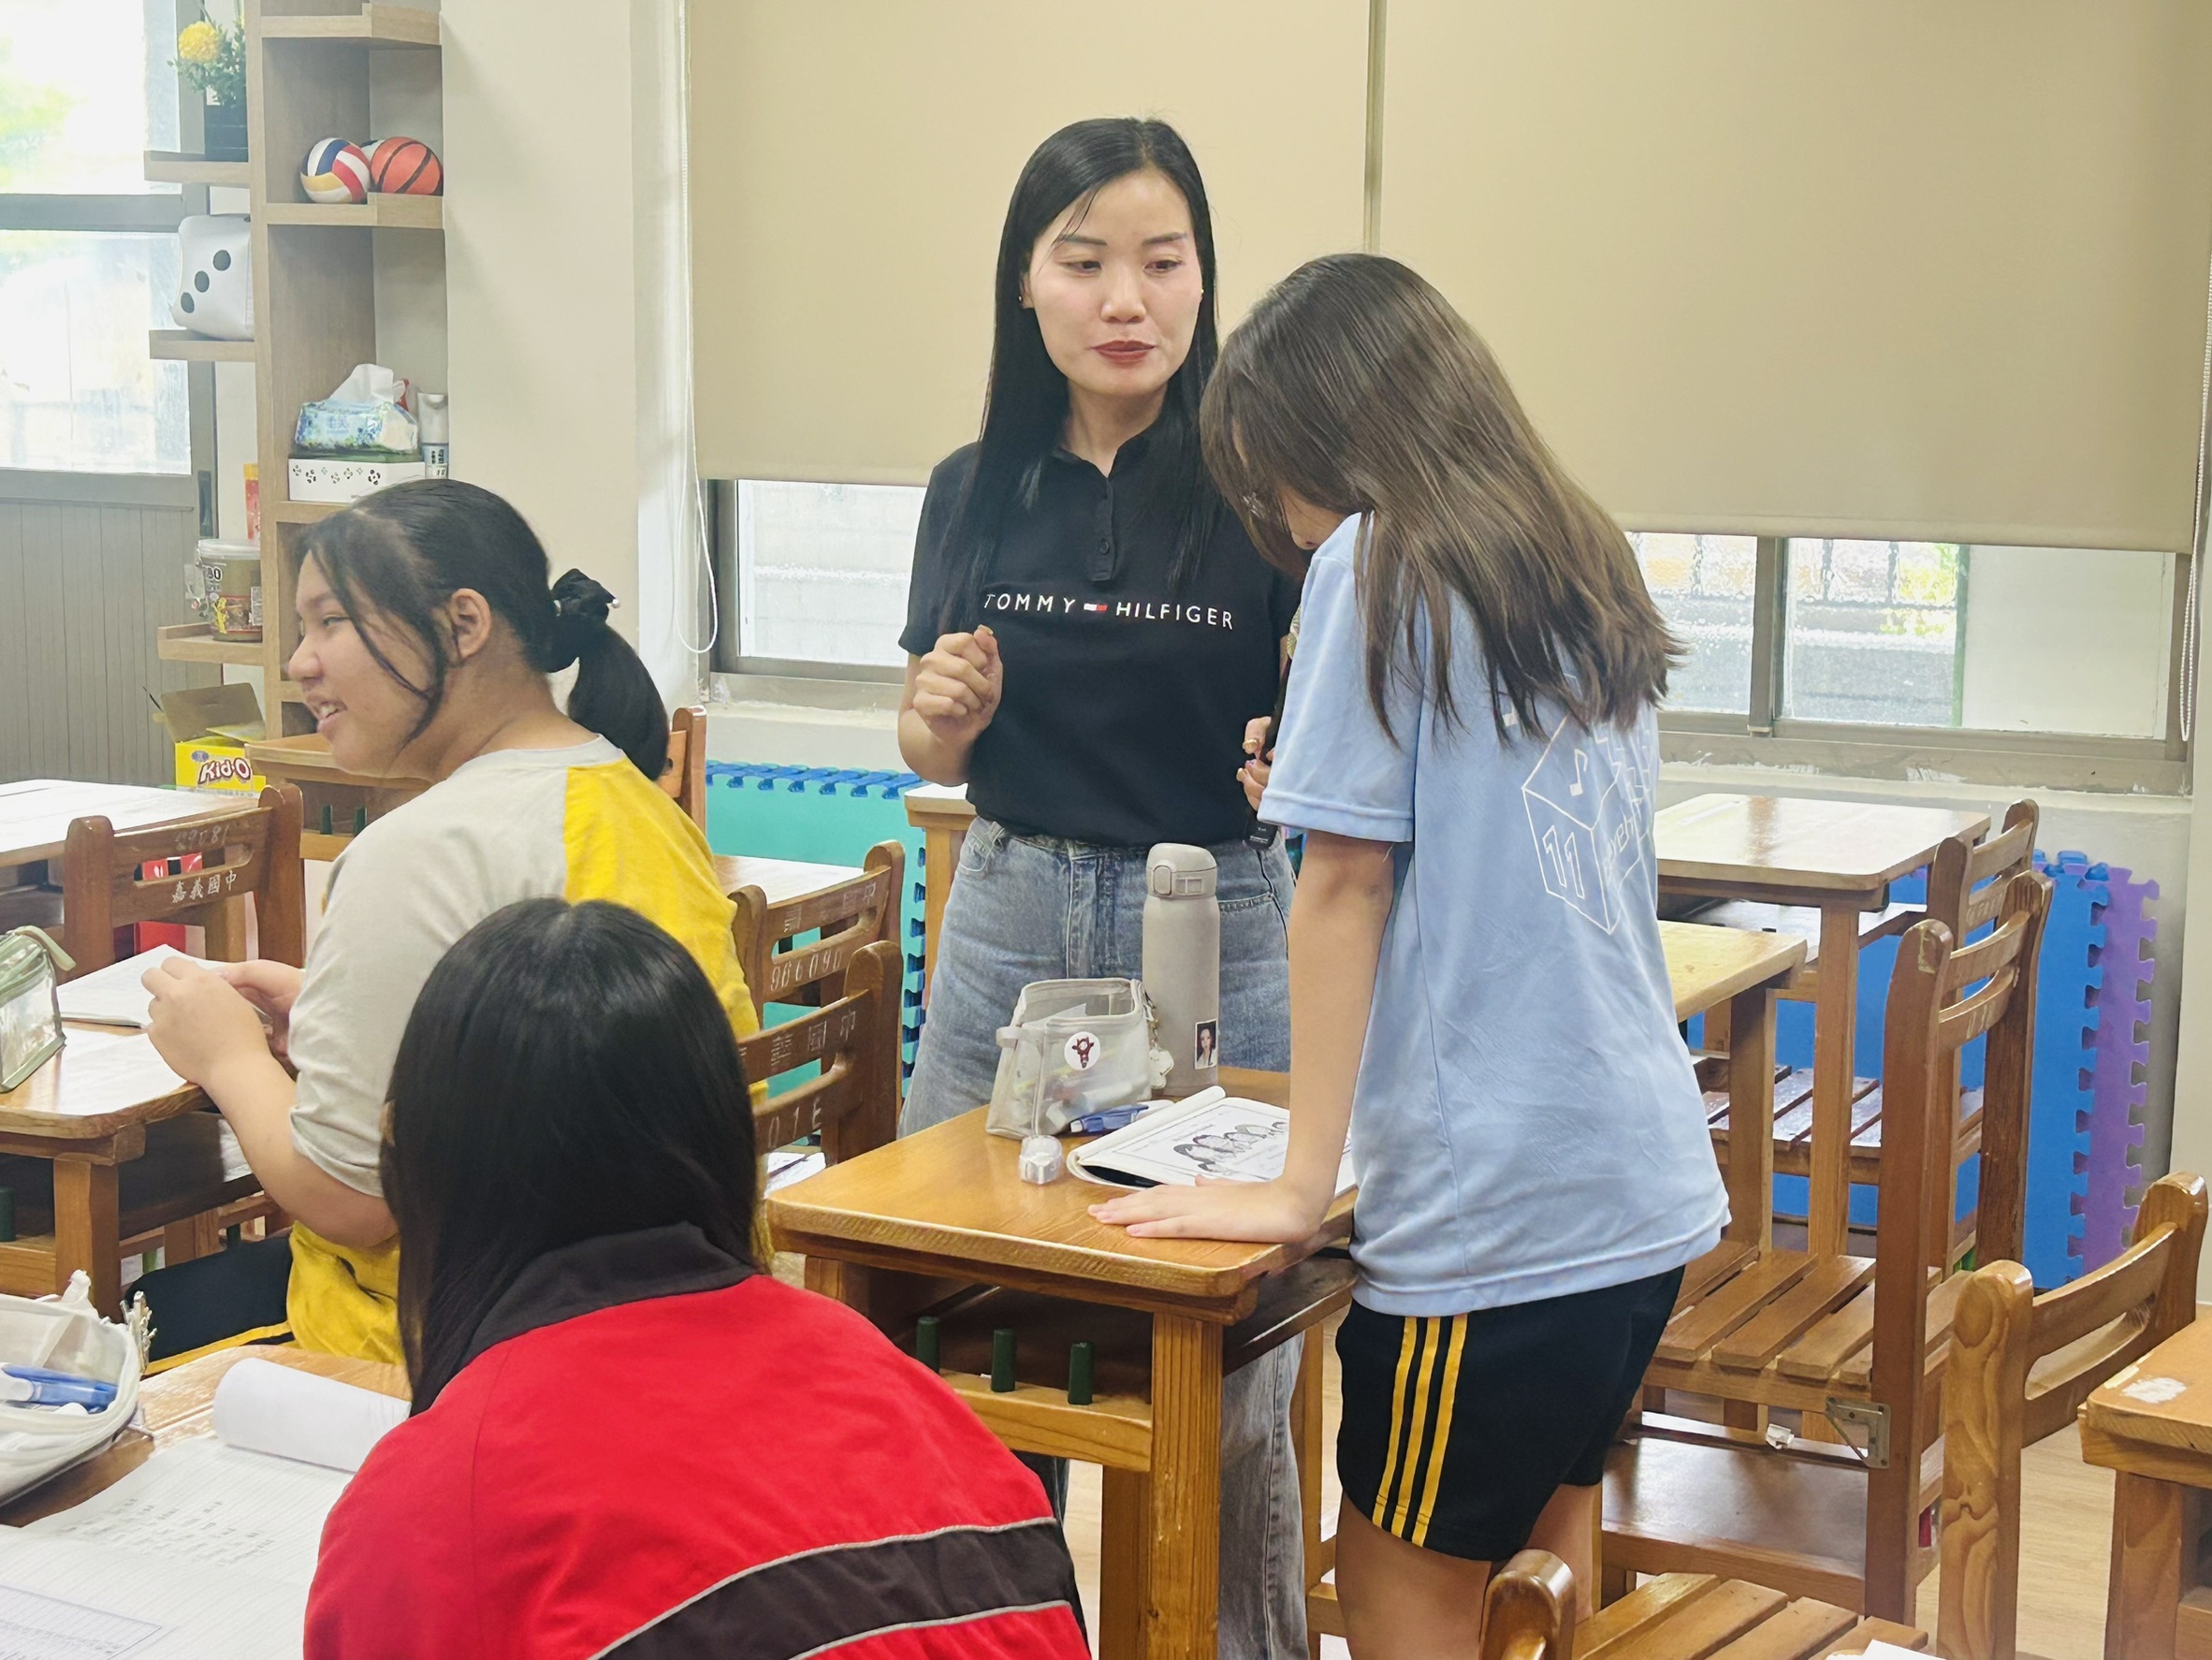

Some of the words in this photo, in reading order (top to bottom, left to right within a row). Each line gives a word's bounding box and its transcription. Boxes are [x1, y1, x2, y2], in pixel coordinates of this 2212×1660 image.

[983, 593, 1075, 613] TOMMY
[1115, 602, 1233, 630] HILFIGER
[171, 869, 237, 903] 嘉義國中
